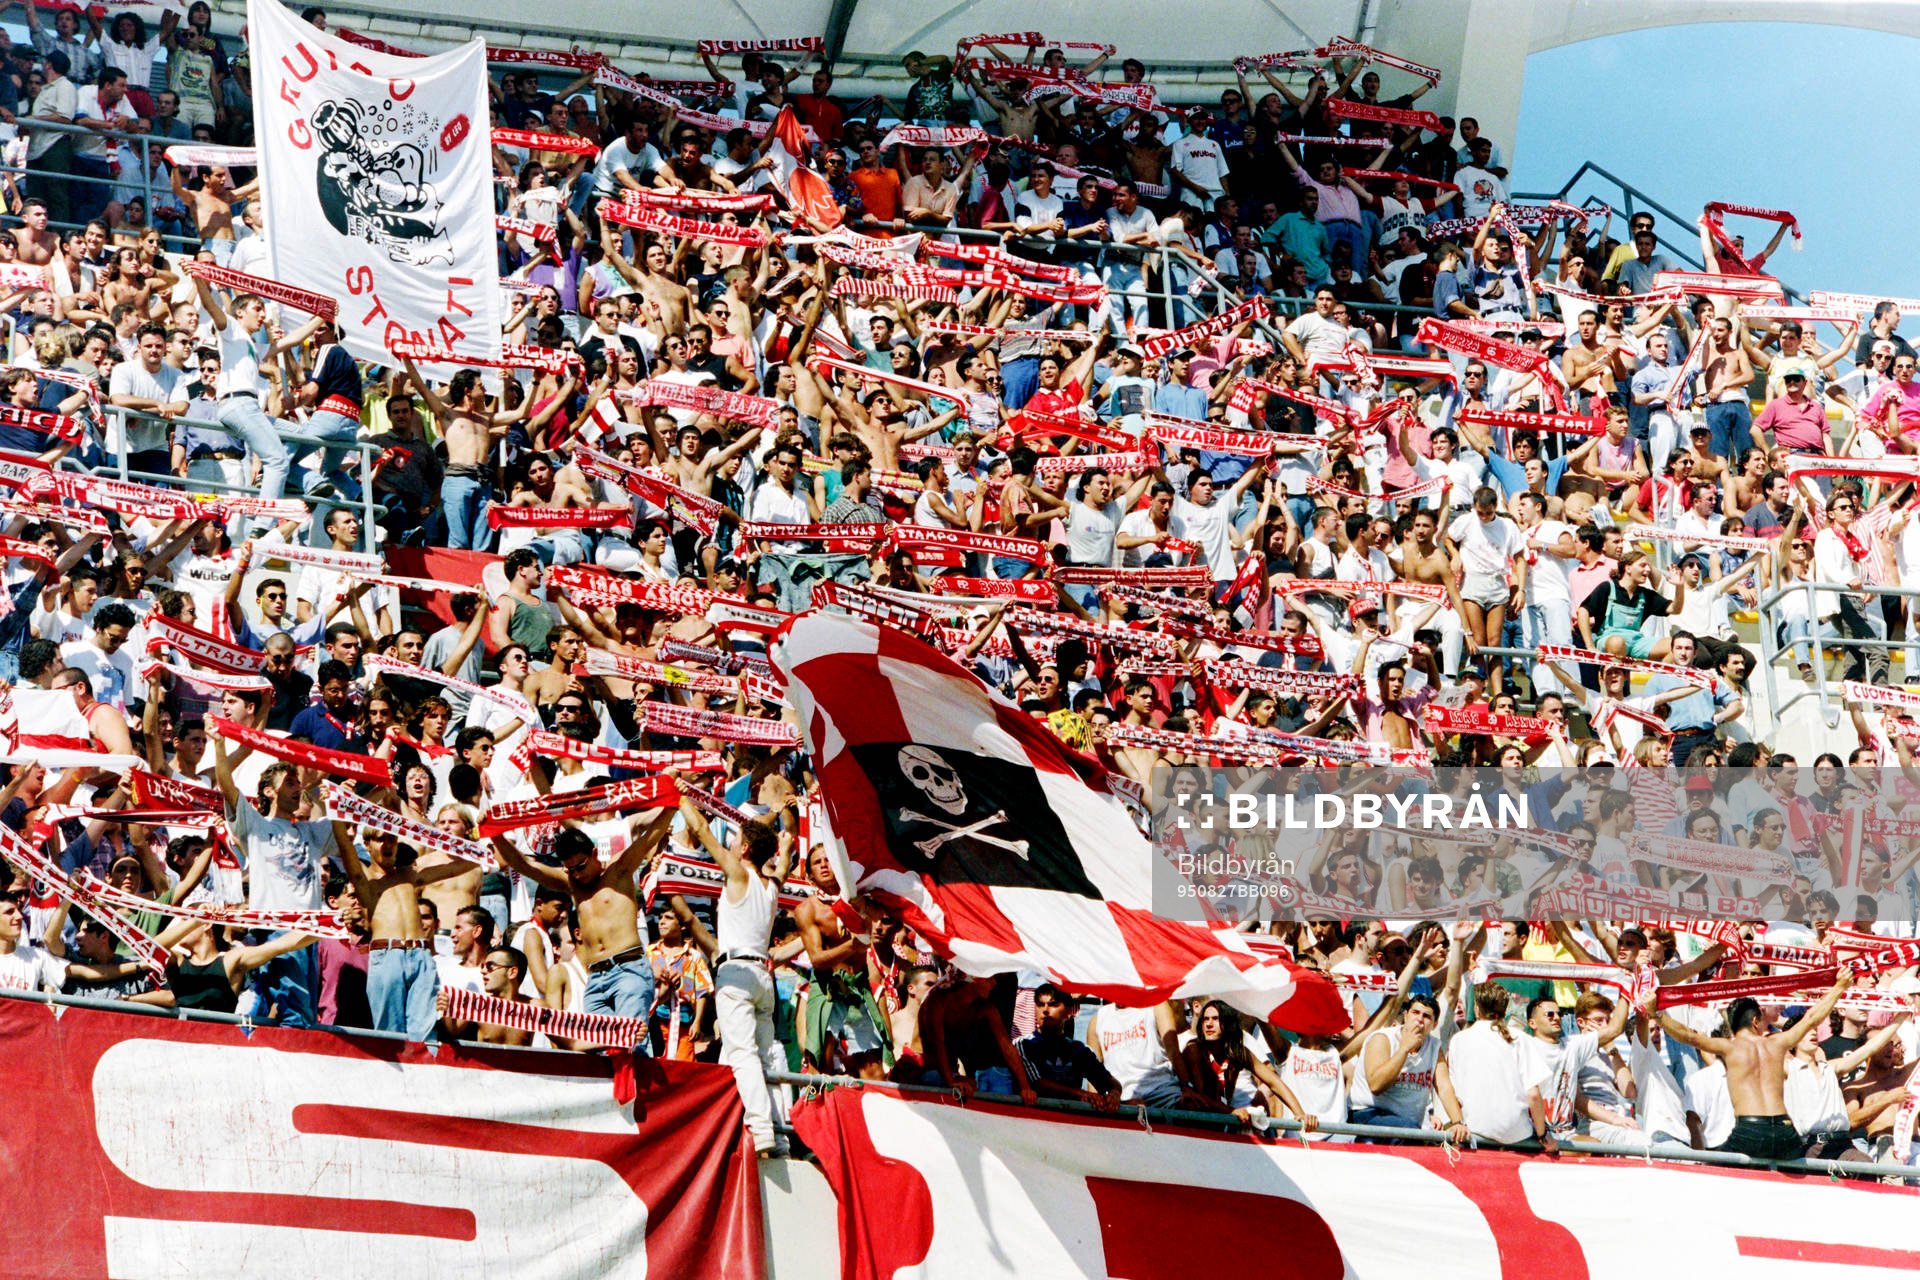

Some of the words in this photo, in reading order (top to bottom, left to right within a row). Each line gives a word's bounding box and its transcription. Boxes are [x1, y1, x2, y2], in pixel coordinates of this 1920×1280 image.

[627, 206, 679, 231] FORZA
[697, 221, 738, 240] BARI
[1467, 408, 1537, 425] ULTRAS
[1554, 419, 1594, 432] BARI
[1225, 432, 1271, 449] BARI
[1096, 454, 1128, 468] BARI
[818, 524, 877, 538] STAMPO
[897, 528, 959, 544] STAMPO
[969, 534, 1039, 556] ITALIANO
[165, 627, 248, 668] ULTRAS
[568, 743, 690, 769] ULTRAS
[605, 777, 658, 802] BARI
[664, 863, 725, 882] FORZ
[1103, 1019, 1147, 1052] ULTRAS
[1293, 1055, 1339, 1081] ULTRAS
